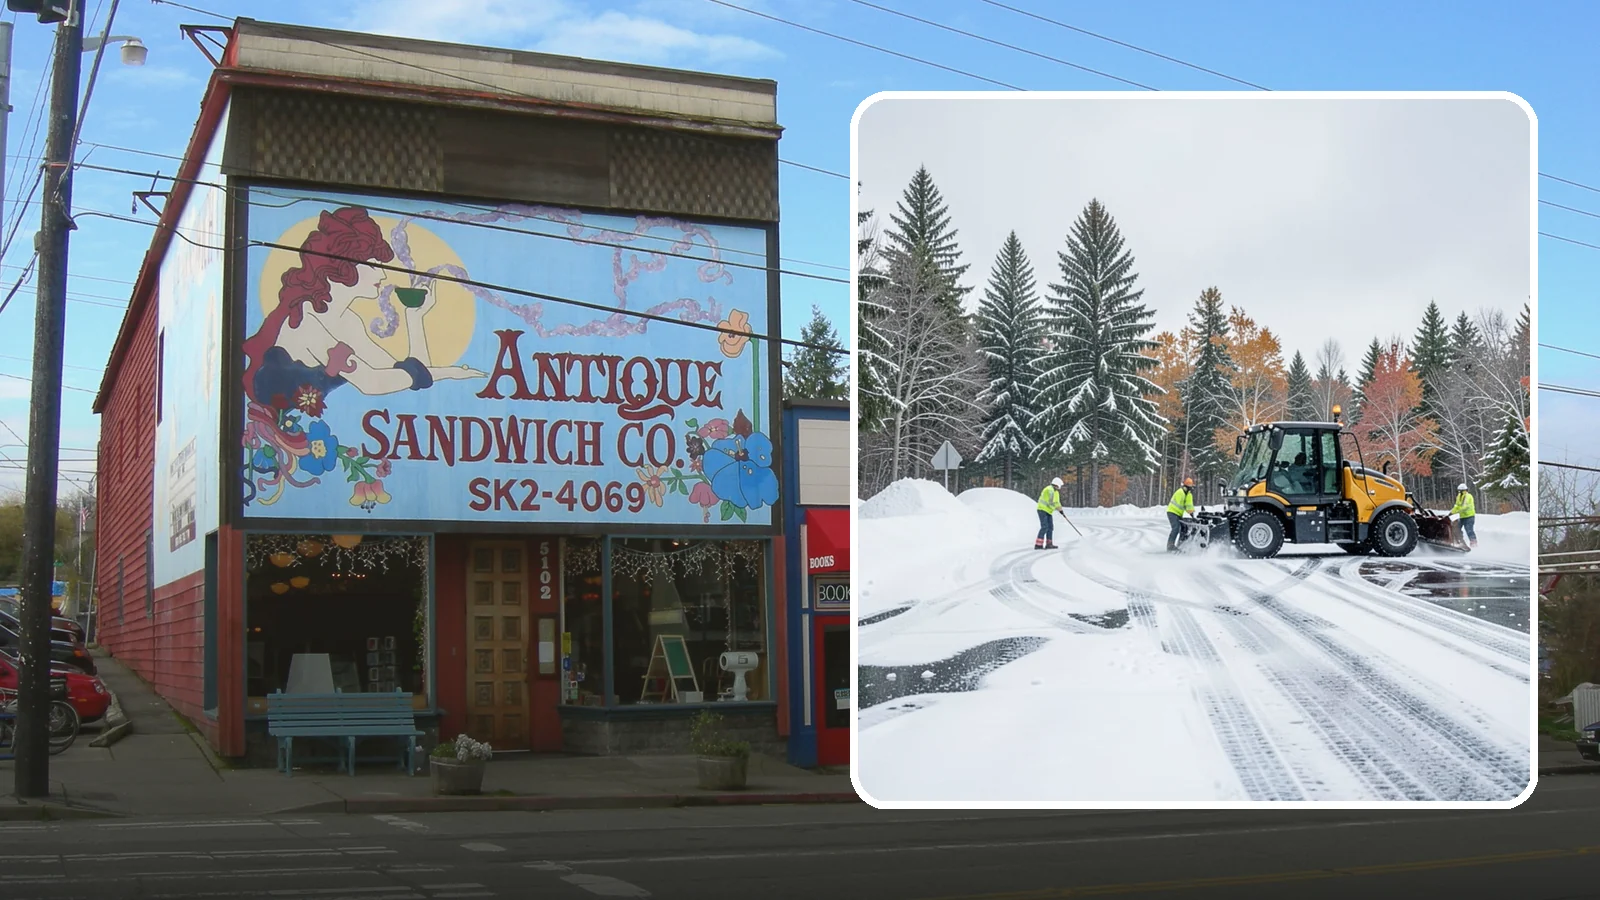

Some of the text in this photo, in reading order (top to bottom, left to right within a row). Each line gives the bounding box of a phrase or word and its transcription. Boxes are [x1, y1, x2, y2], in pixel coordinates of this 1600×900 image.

[476, 329, 724, 421] ANTIQUE
[361, 409, 685, 469] SANDWICH CO.
[467, 477, 646, 513] SK2-4069
[540, 542, 551, 600] 5102
[809, 555, 835, 569] BOOKS
